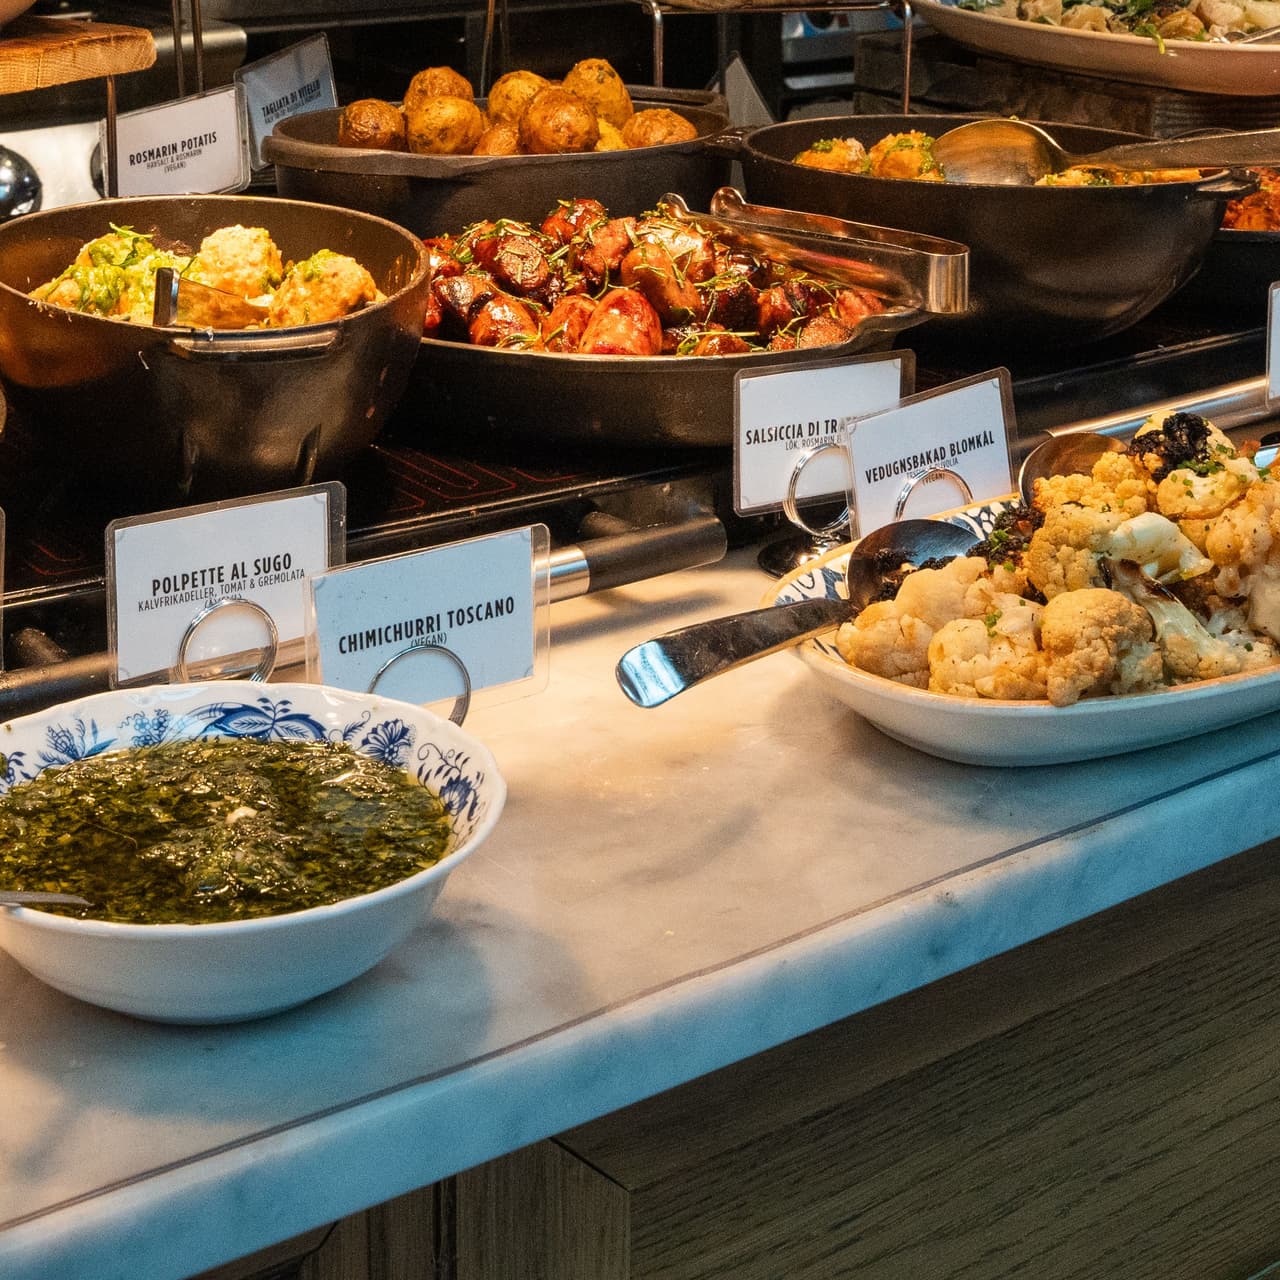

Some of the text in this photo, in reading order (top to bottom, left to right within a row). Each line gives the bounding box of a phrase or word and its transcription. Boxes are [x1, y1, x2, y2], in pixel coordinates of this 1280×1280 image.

[261, 95, 290, 118] TAGLIATA
[129, 131, 217, 166] ROSMARIN POTATIS
[175, 149, 202, 161] ROSMARIN
[164, 161, 186, 174] (VEGAN)
[746, 423, 803, 445] SALSICCIA
[808, 421, 819, 437] DI
[865, 446, 946, 484] VEDUGNSBAKAD
[949, 430, 995, 457] BLOMKÅL
[152, 553, 292, 596] POLPETTE AL SUGO
[138, 585, 217, 612] KALVFRIKADELLER,
[220, 579, 247, 595] TOMAT
[249, 578, 255, 589] &
[258, 568, 305, 587] GREMOLATA
[339, 596, 514, 654] CHIMICHURRI TOSCANO
[410, 632, 448, 648] (VEGAN)
